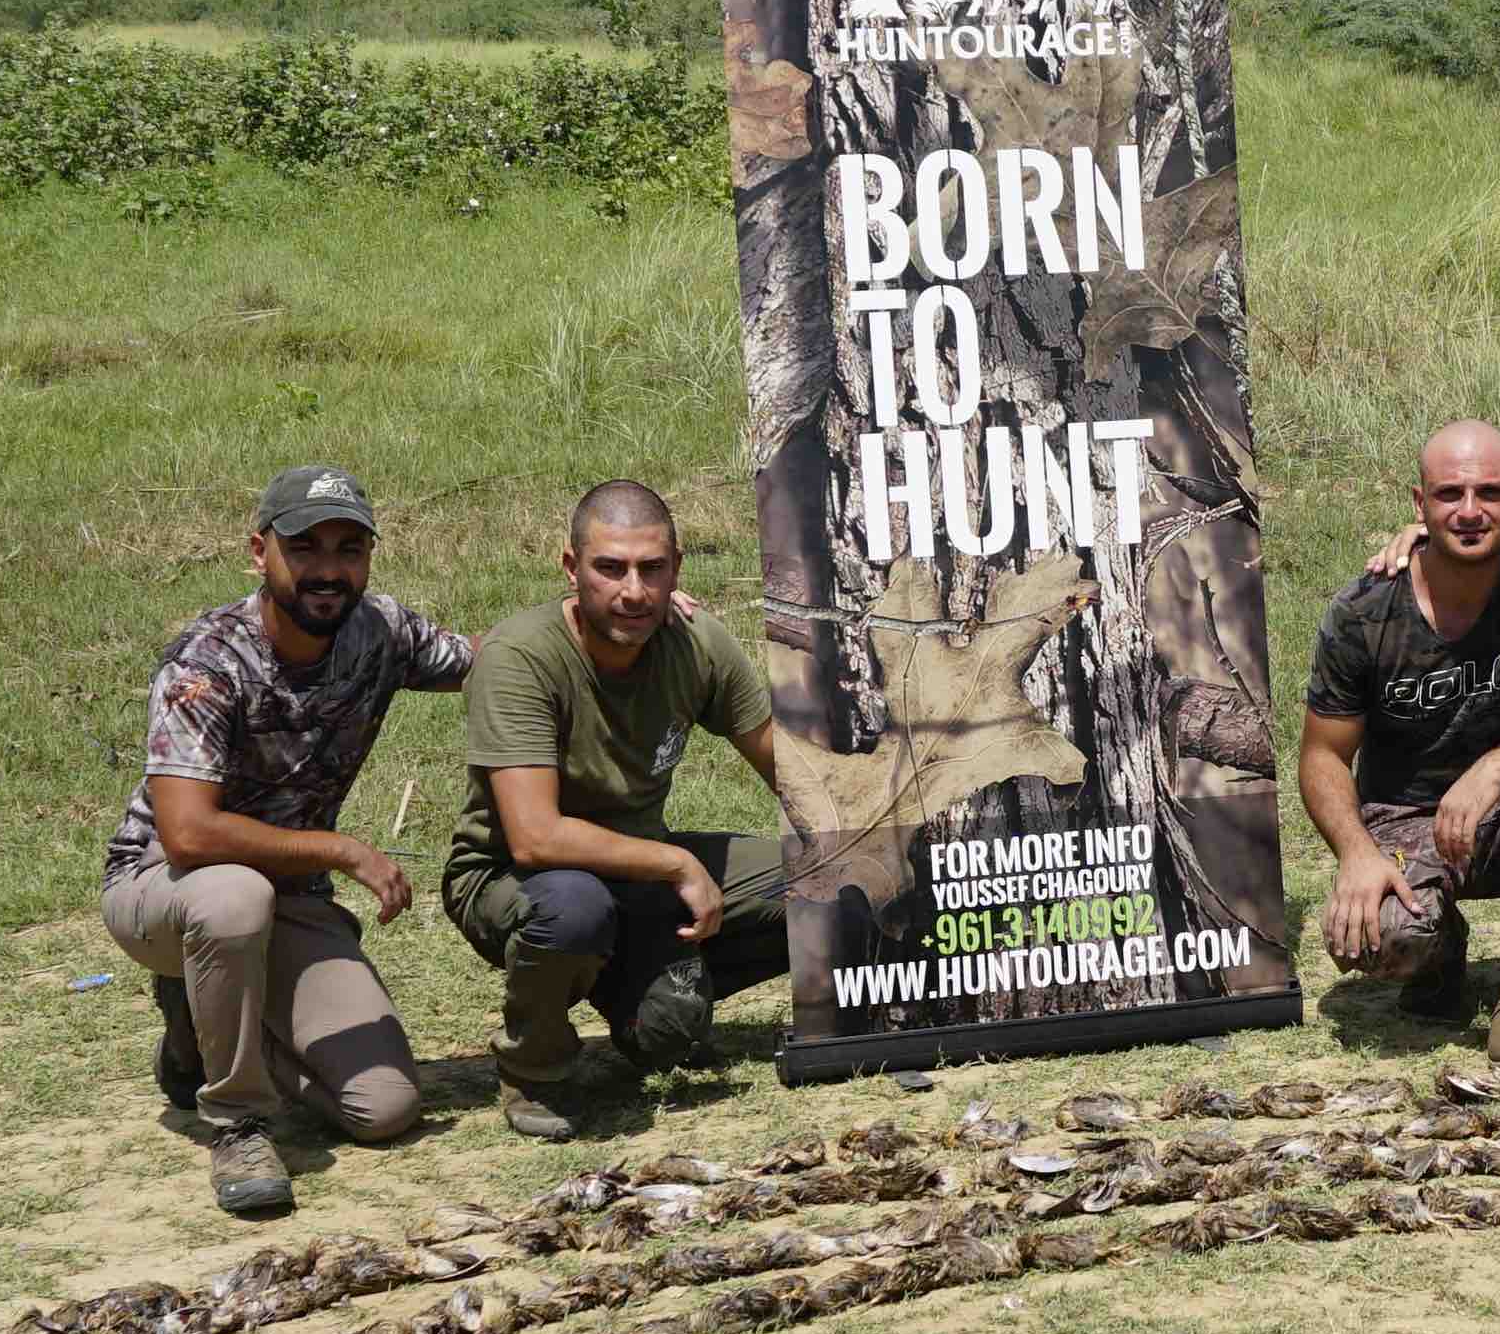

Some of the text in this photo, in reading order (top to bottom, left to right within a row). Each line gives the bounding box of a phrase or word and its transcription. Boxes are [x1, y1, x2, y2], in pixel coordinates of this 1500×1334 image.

[837, 22, 1116, 62] HUNTOURAGE
[839, 145, 1147, 282] BORN
[850, 285, 981, 428] TO
[859, 419, 1154, 561] HUNT
[930, 824, 1152, 881] FOR MORE INFO
[932, 863, 1153, 910] YOUSSEF CHAGOURY
[921, 894, 1157, 955] +961-3-140992
[833, 927, 1251, 1008] WWW.HUNTOURAGE.COM
